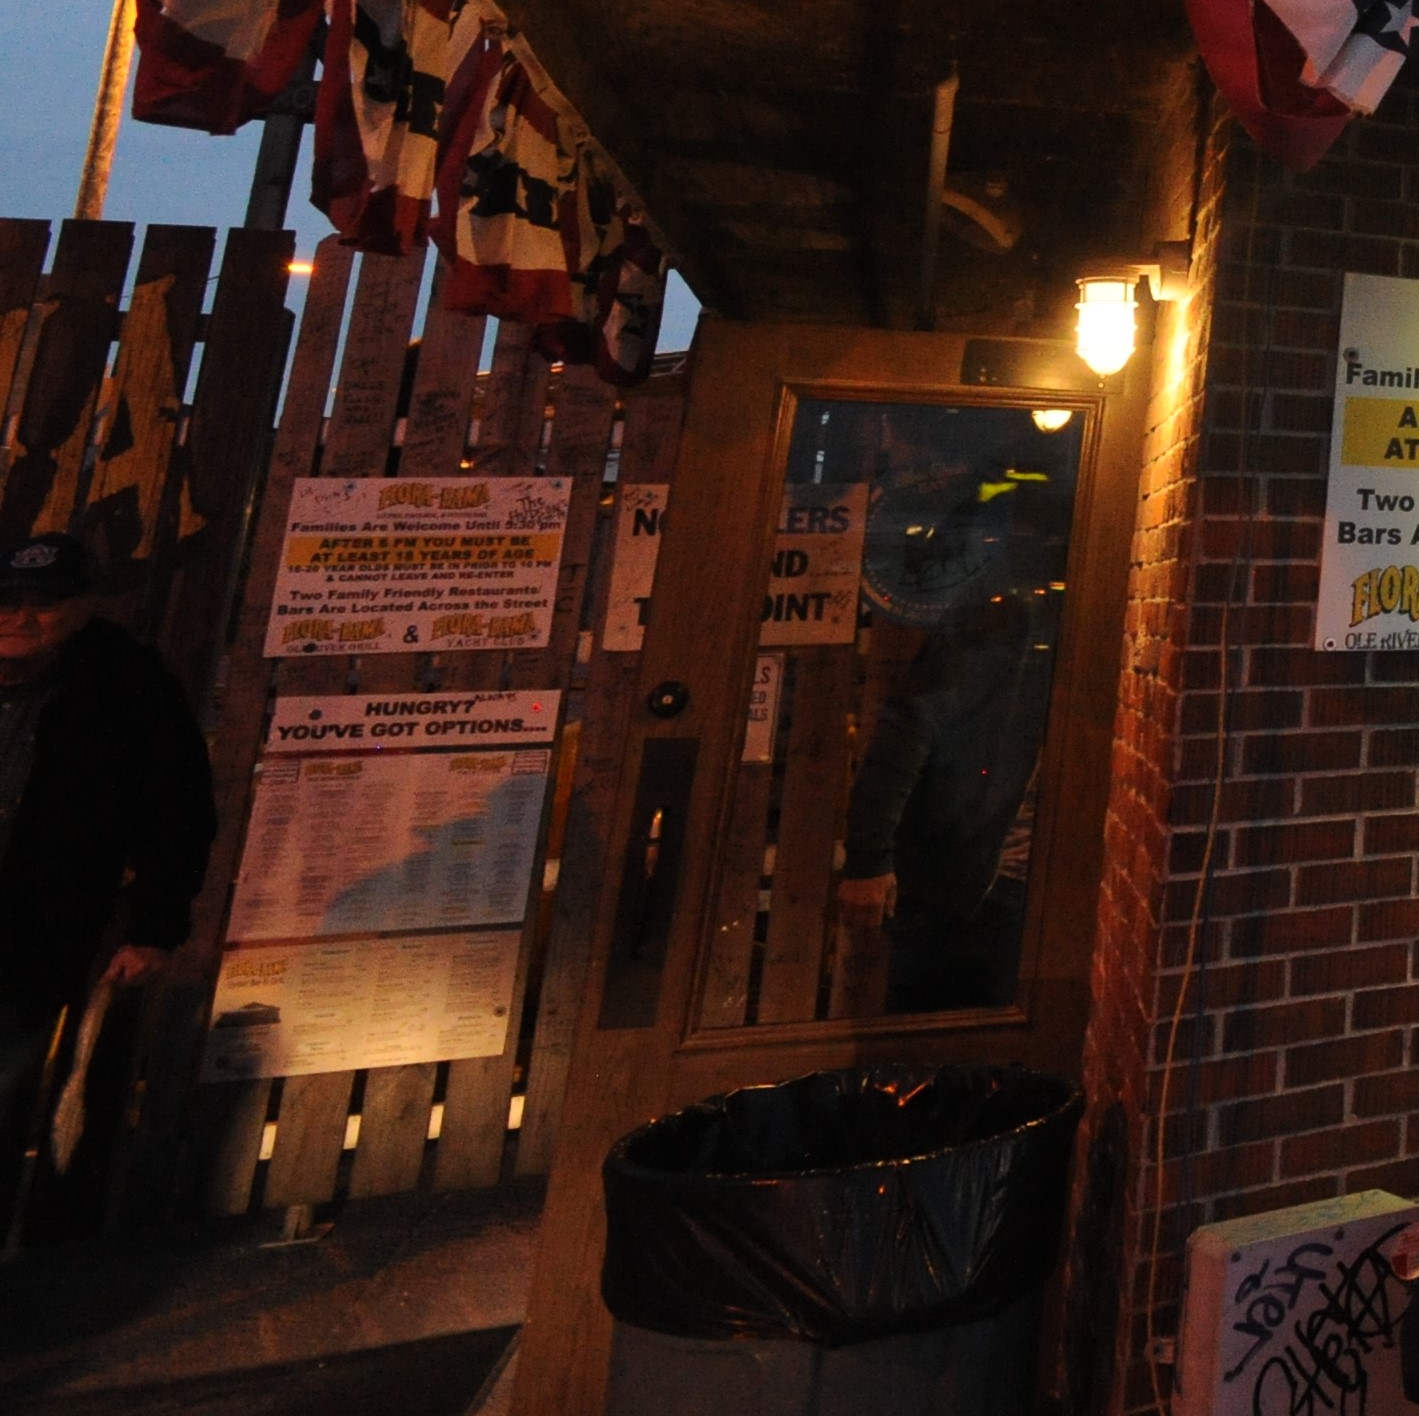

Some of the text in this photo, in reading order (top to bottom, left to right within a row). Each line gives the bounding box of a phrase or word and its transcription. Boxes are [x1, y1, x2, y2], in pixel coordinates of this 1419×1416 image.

[1357, 488, 1415, 512] Two
[291, 522, 357, 532] Families
[362, 522, 388, 531] Are
[393, 521, 460, 531] Welcome
[466, 520, 500, 530] Until
[540, 522, 561, 531] pm
[787, 506, 850, 534] ERS
[1337, 521, 1402, 545] Bars
[319, 538, 374, 549] AFTER
[393, 537, 417, 548] PM
[423, 537, 456, 547] YOU
[460, 536, 506, 546] MUST
[510, 536, 531, 546] BE
[310, 548, 534, 563] AT LEAST 18 YEARS OF AGE
[771, 550, 809, 577] ND
[324, 564, 356, 572] YEAR
[393, 563, 425, 571] MUST
[339, 573, 388, 582] CANNOT
[390, 572, 428, 581] LEAVE
[459, 570, 514, 579] RE-ENTER
[290, 590, 323, 601] Two
[327, 589, 378, 602] Family
[383, 587, 443, 599] Friendly
[277, 597, 548, 615] Bars Are Located Across the Street
[760, 593, 832, 622] OINT
[403, 625, 418, 644] &
[446, 637, 488, 648] YACHT
[1345, 632, 1377, 649] OLE
[365, 699, 476, 717] HUNGRY?
[278, 723, 365, 741] YOU'VE
[370, 721, 420, 737] GOT
